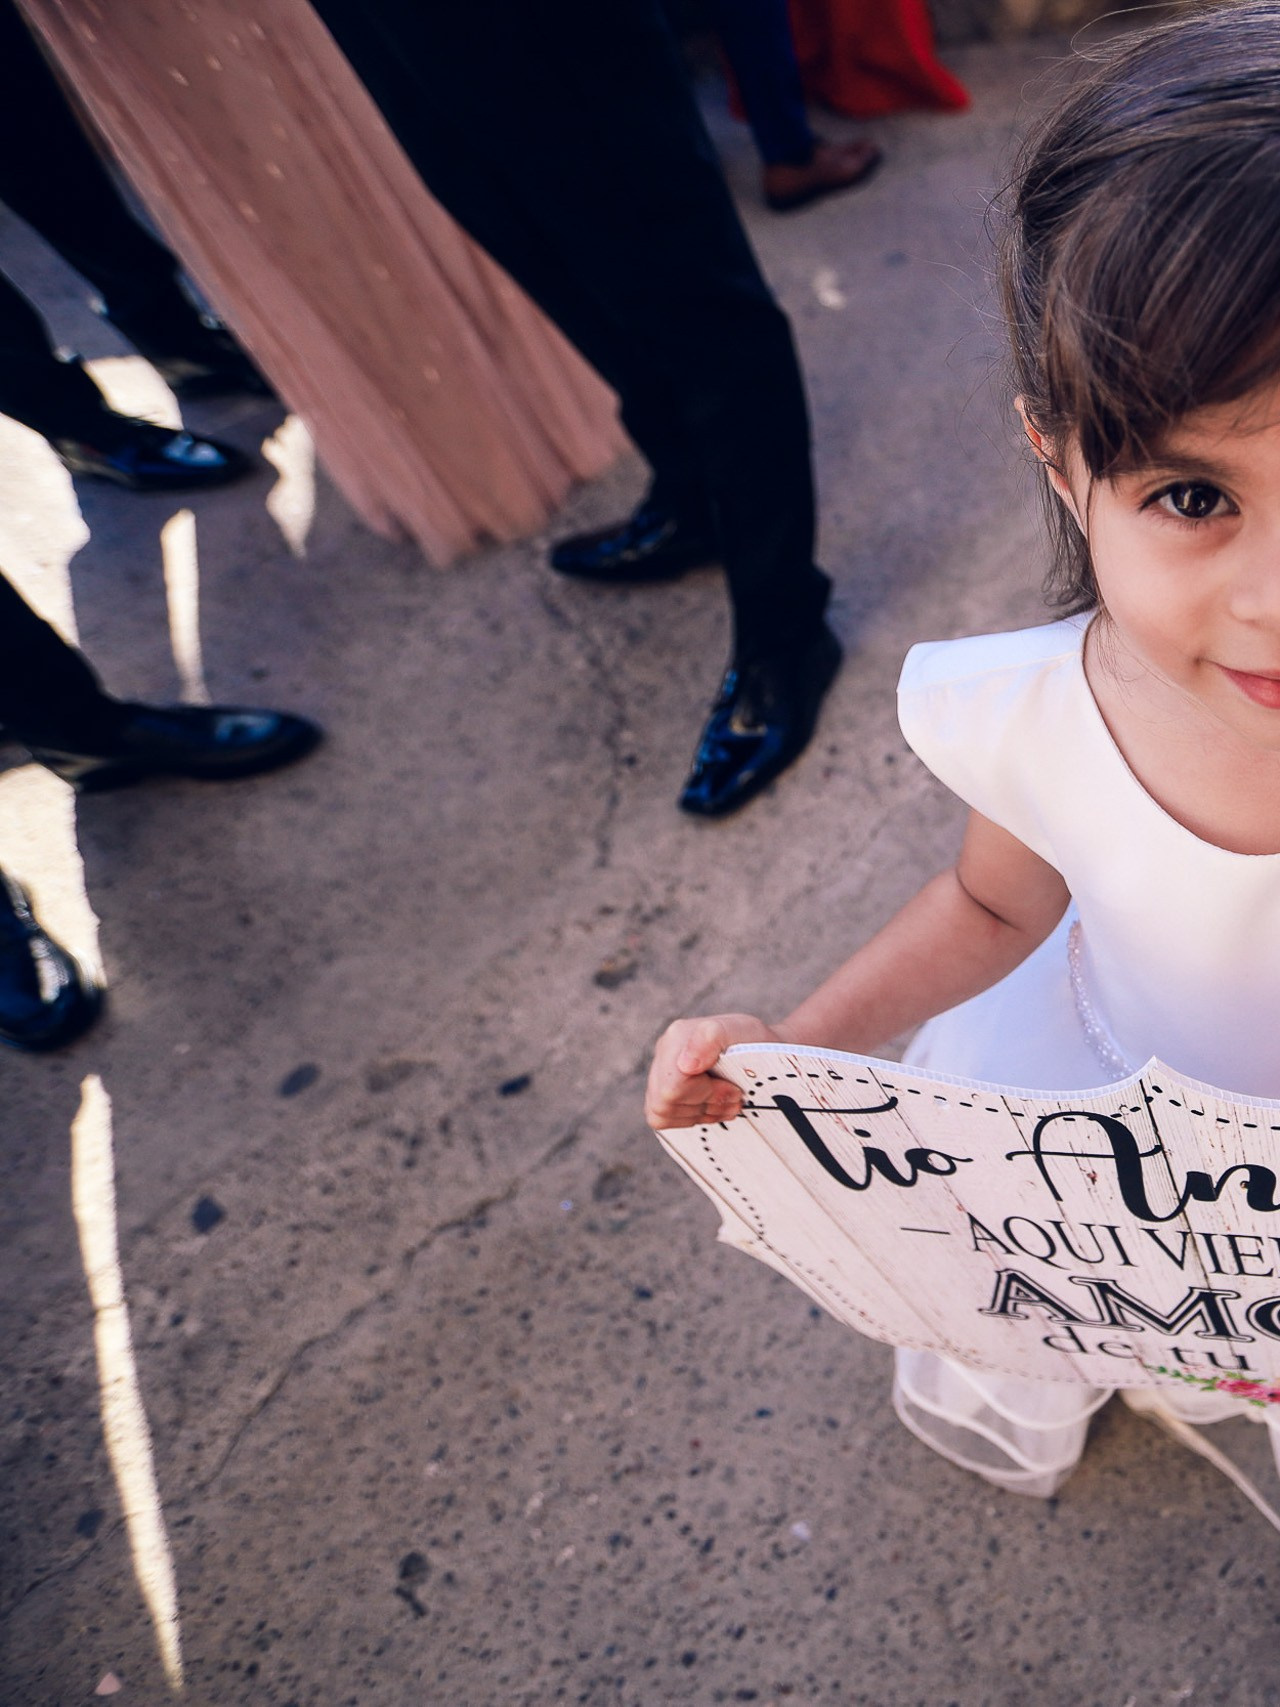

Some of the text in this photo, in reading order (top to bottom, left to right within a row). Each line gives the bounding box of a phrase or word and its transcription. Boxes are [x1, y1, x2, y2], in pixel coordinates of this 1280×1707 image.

[966, 1212, 1138, 1270] AQUI
[1043, 1326, 1136, 1358] de
[1172, 1346, 1262, 1371] tu
